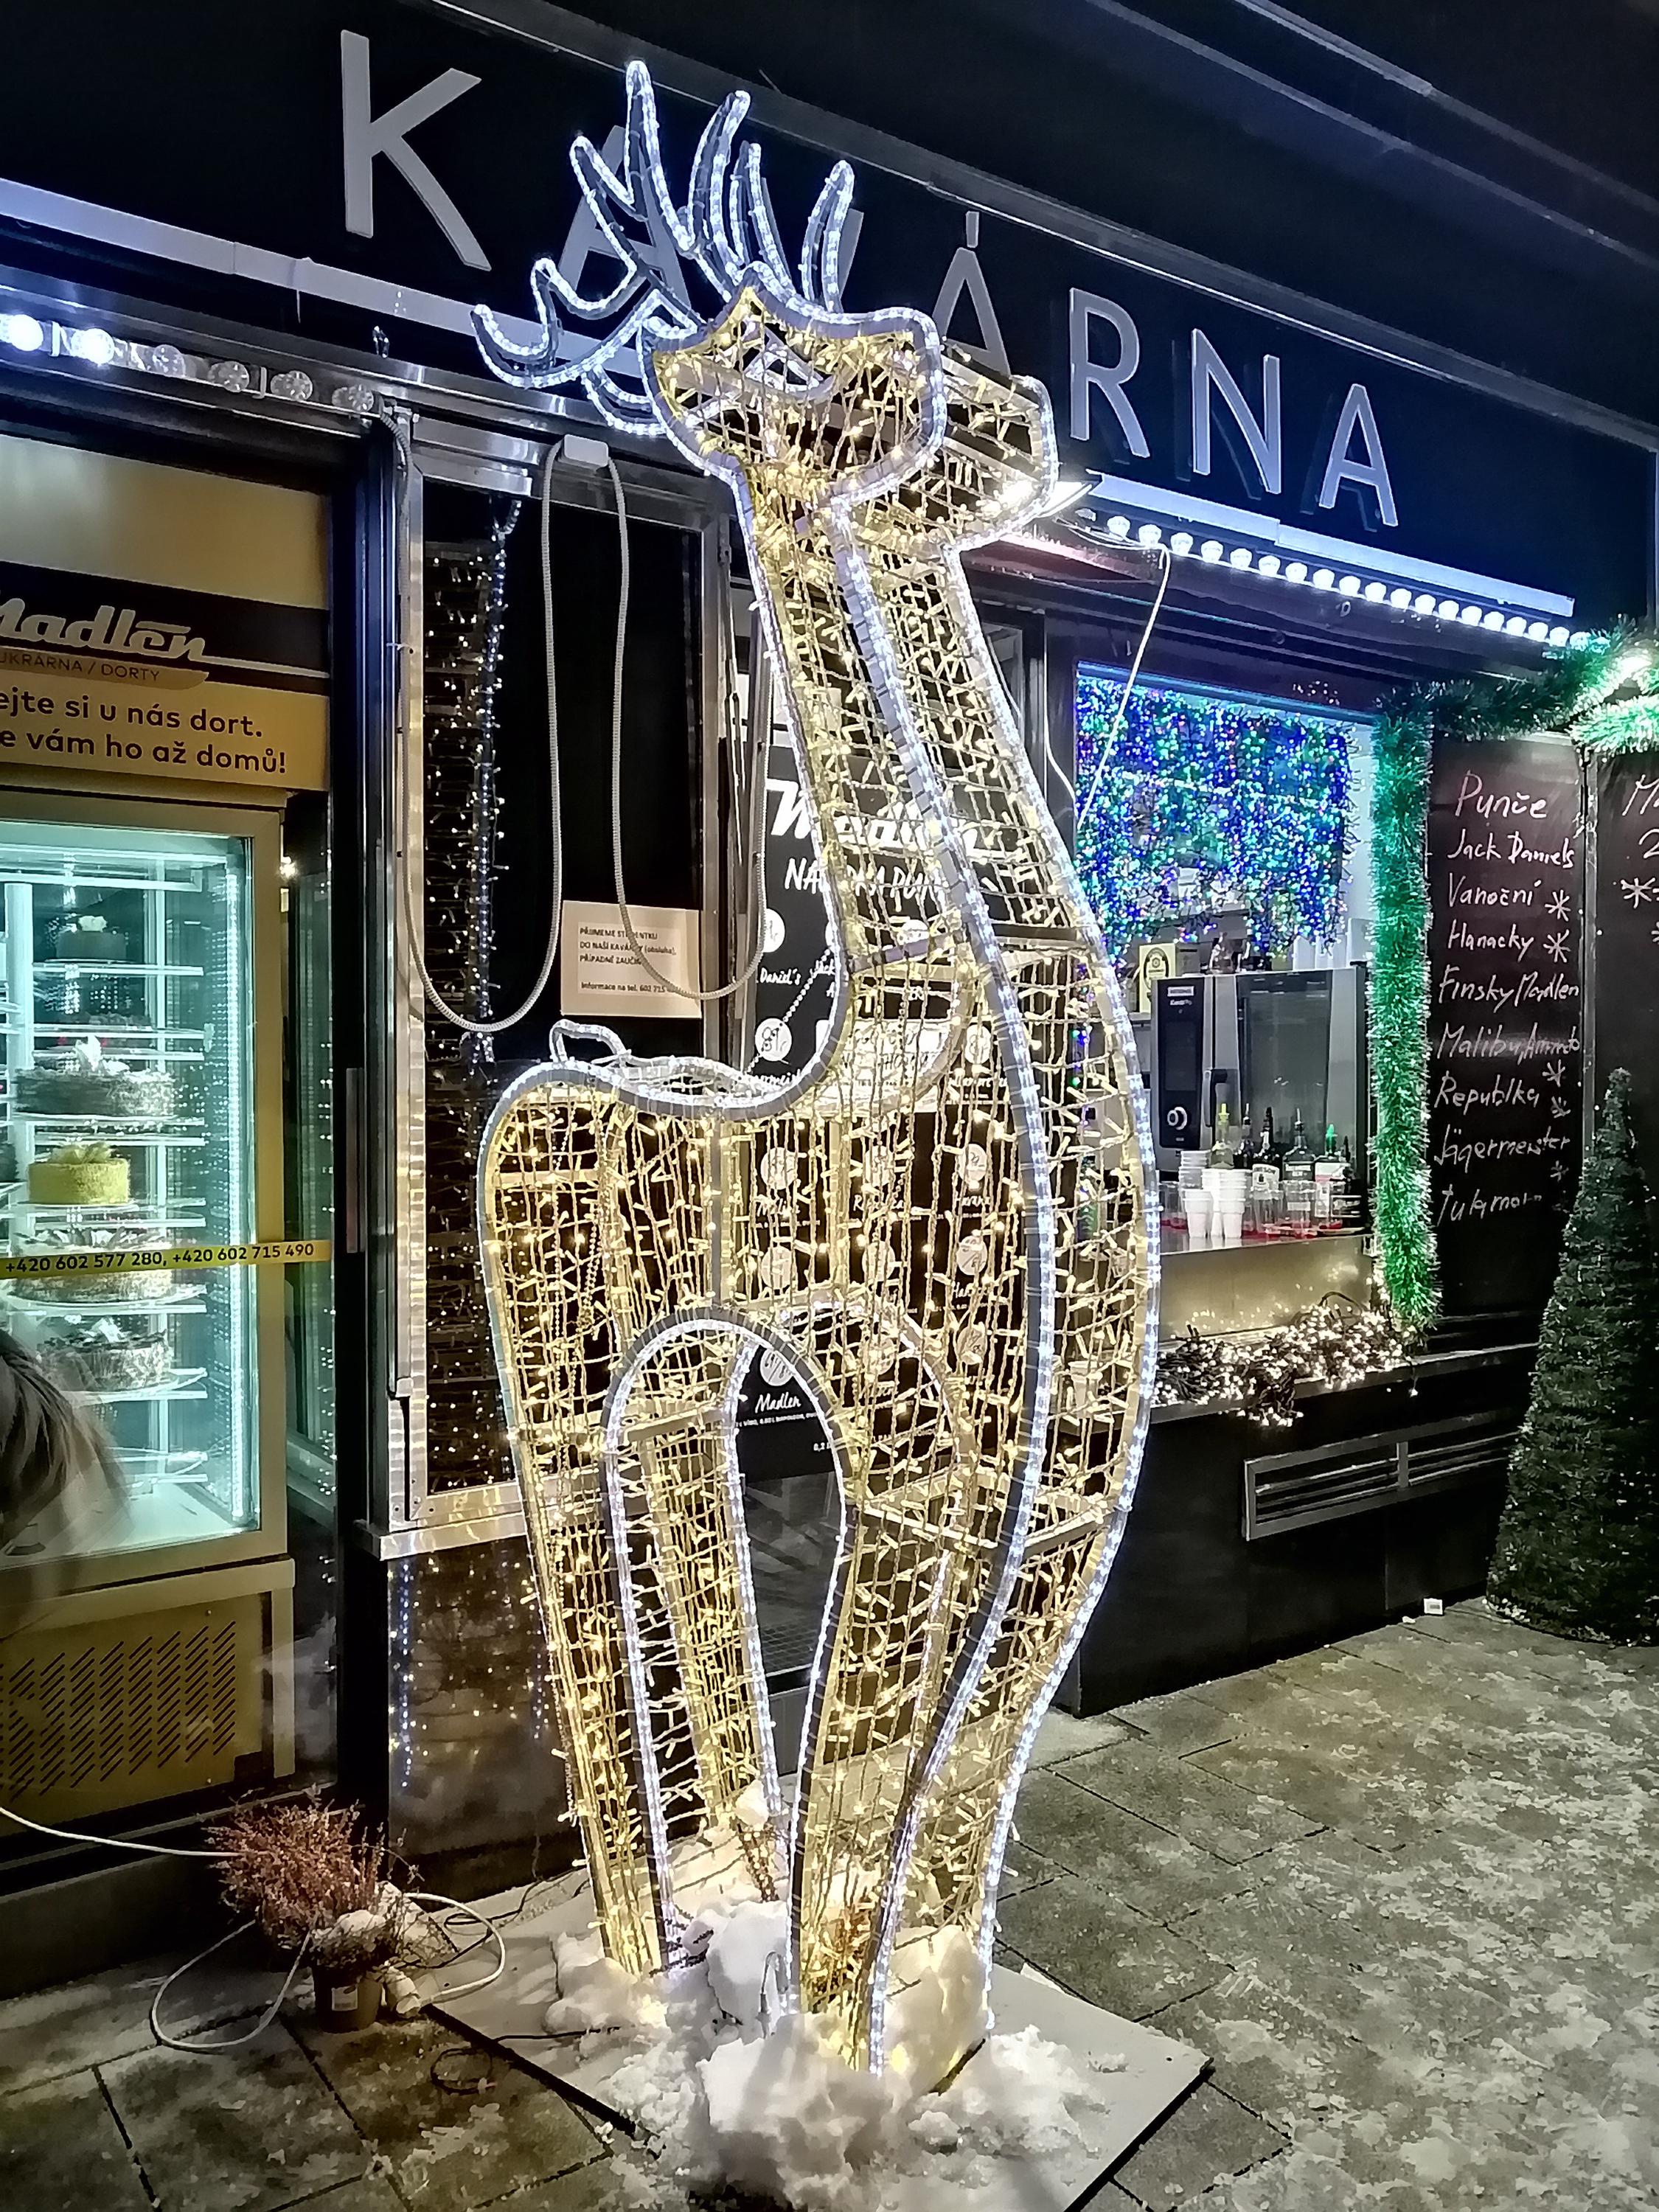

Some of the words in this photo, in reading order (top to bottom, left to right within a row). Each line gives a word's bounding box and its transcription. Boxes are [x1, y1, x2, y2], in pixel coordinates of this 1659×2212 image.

[339, 29, 1399, 528] KAÁRNA
[100, 663, 161, 681] DORTY
[65, 695, 89, 719] si
[100, 703, 116, 722] u
[128, 703, 181, 728] nás
[190, 709, 262, 737] dort.
[26, 728, 94, 756] vám
[105, 734, 143, 760] ho
[152, 742, 187, 765] až
[196, 745, 286, 774] domů!
[1447, 828, 1501, 860] Jack
[580, 941, 591, 949] DO
[5, 1259, 51, 1273] +420
[55, 1255, 88, 1270] 602
[93, 1253, 125, 1269] 577
[131, 1251, 167, 1267] 280,
[173, 1248, 213, 1263] +420
[217, 1245, 248, 1261] 602
[251, 1244, 281, 1259] 715
[285, 1242, 314, 1257] 490
